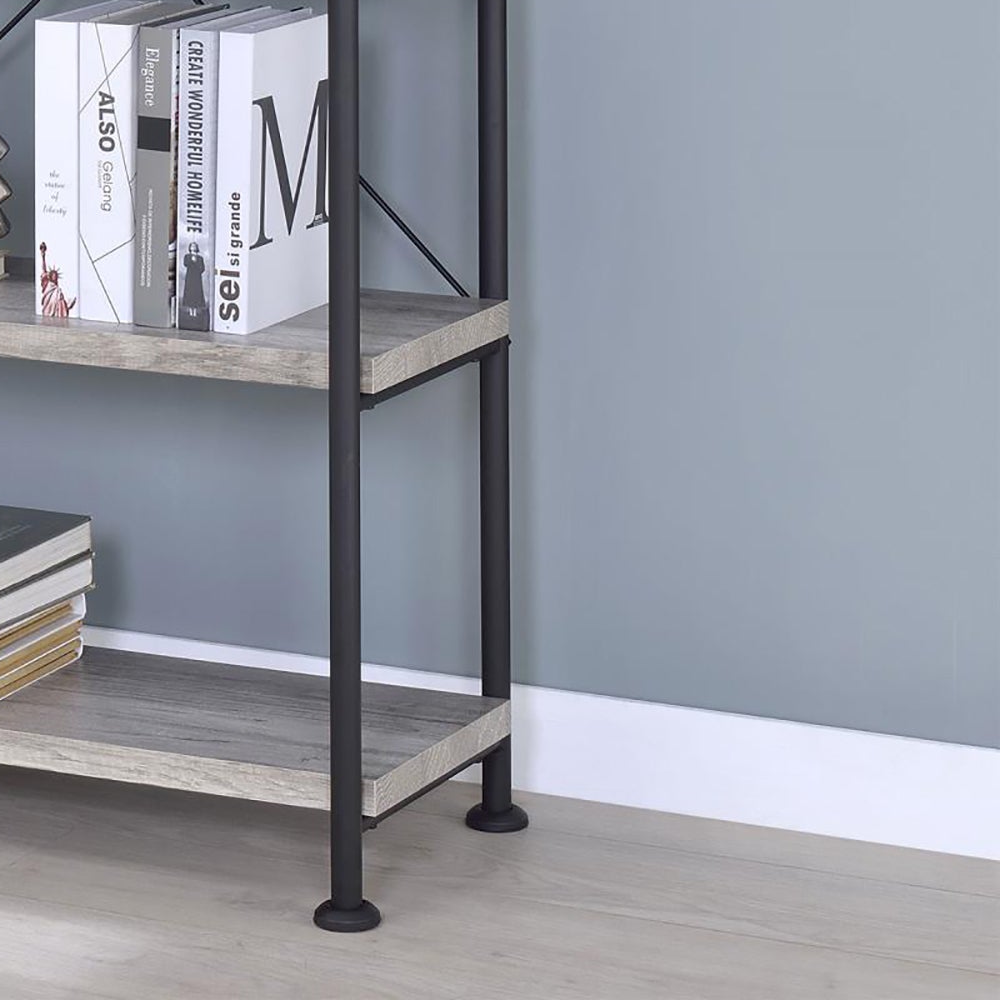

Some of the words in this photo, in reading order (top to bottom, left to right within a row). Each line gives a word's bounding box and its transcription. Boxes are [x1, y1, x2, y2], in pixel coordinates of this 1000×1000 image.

[142, 47, 160, 107] Elegance
[187, 40, 204, 86] CREATE
[98, 91, 115, 153] ALSO
[187, 89, 204, 167] WONDERFUL
[101, 160, 114, 212] Gelang
[248, 78, 328, 250] M
[187, 171, 203, 234] HOMELIFE
[229, 192, 244, 248] grande
[229, 250, 240, 266] si
[213, 269, 241, 323] sei
